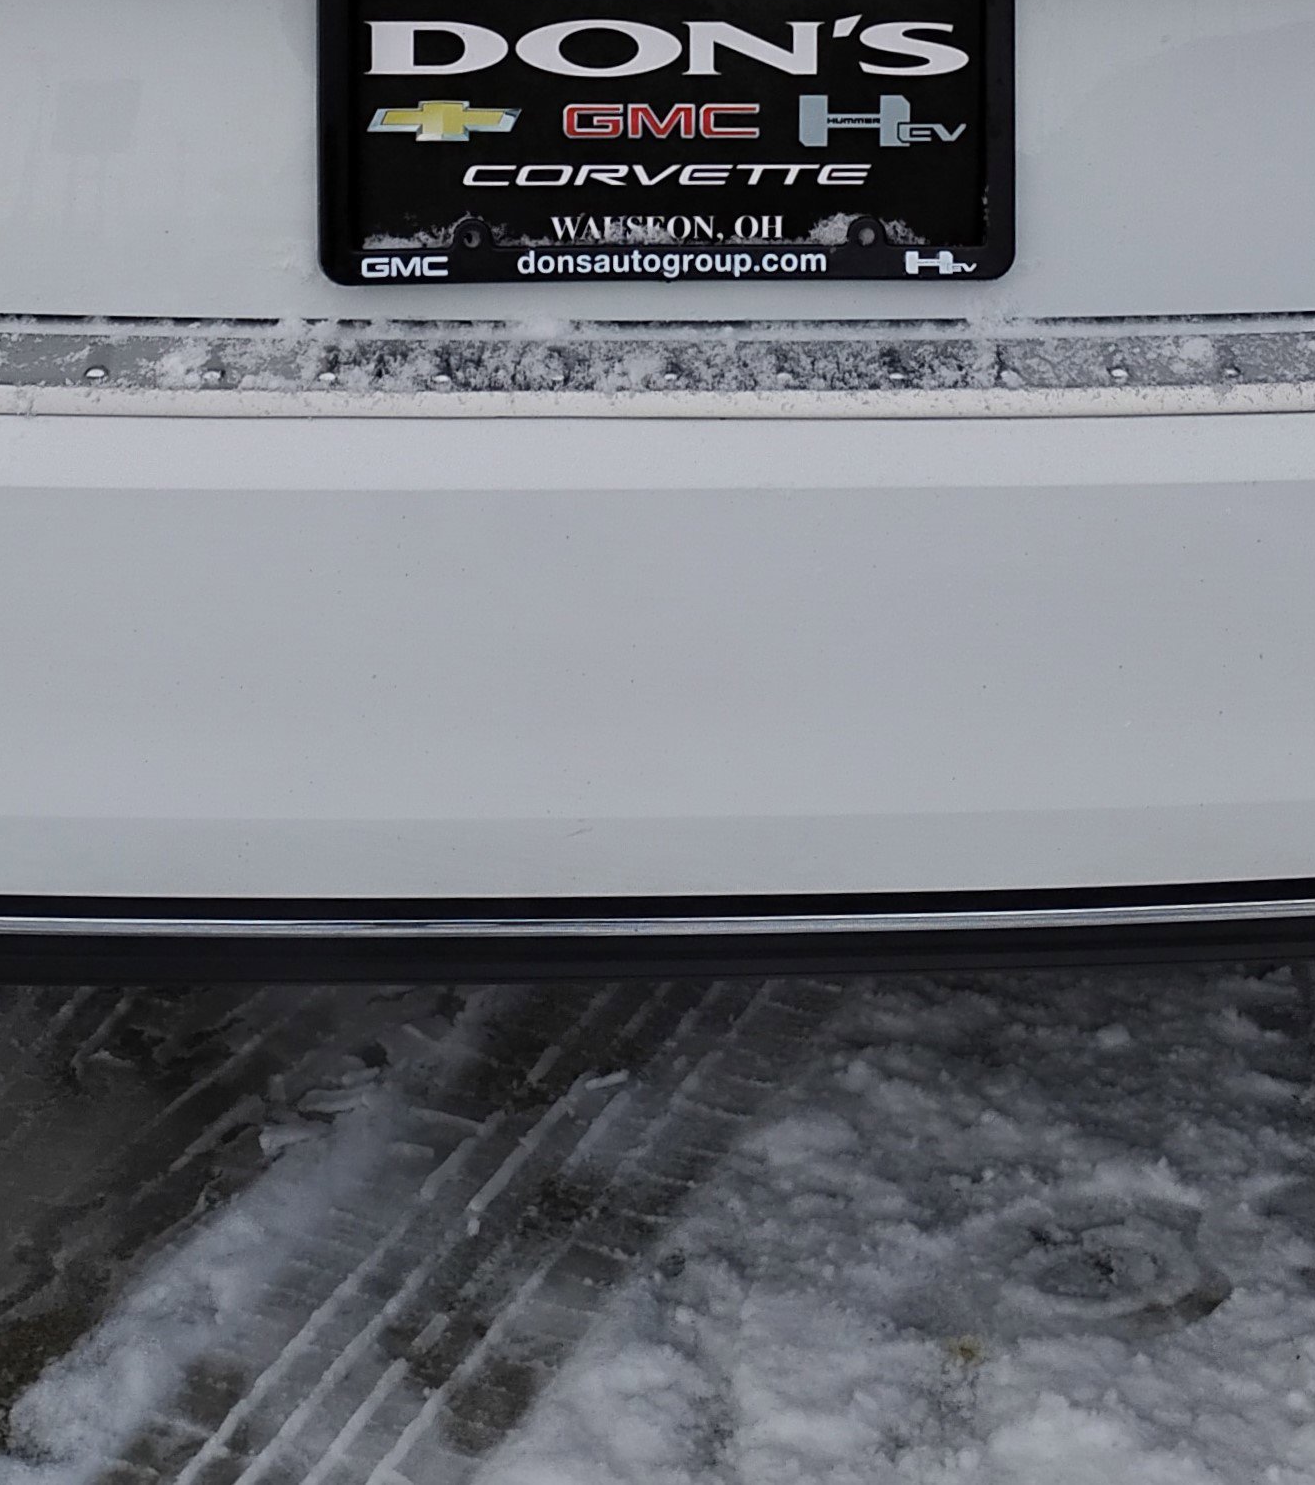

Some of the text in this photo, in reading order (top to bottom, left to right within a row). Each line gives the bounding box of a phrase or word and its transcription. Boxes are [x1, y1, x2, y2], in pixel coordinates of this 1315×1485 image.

[363, 15, 970, 77] DON'S
[563, 103, 760, 139] GMC
[462, 163, 872, 186] CORVETTE
[734, 215, 784, 239] OH
[361, 256, 449, 278] GMC
[517, 249, 827, 278] donsautogroup.com
